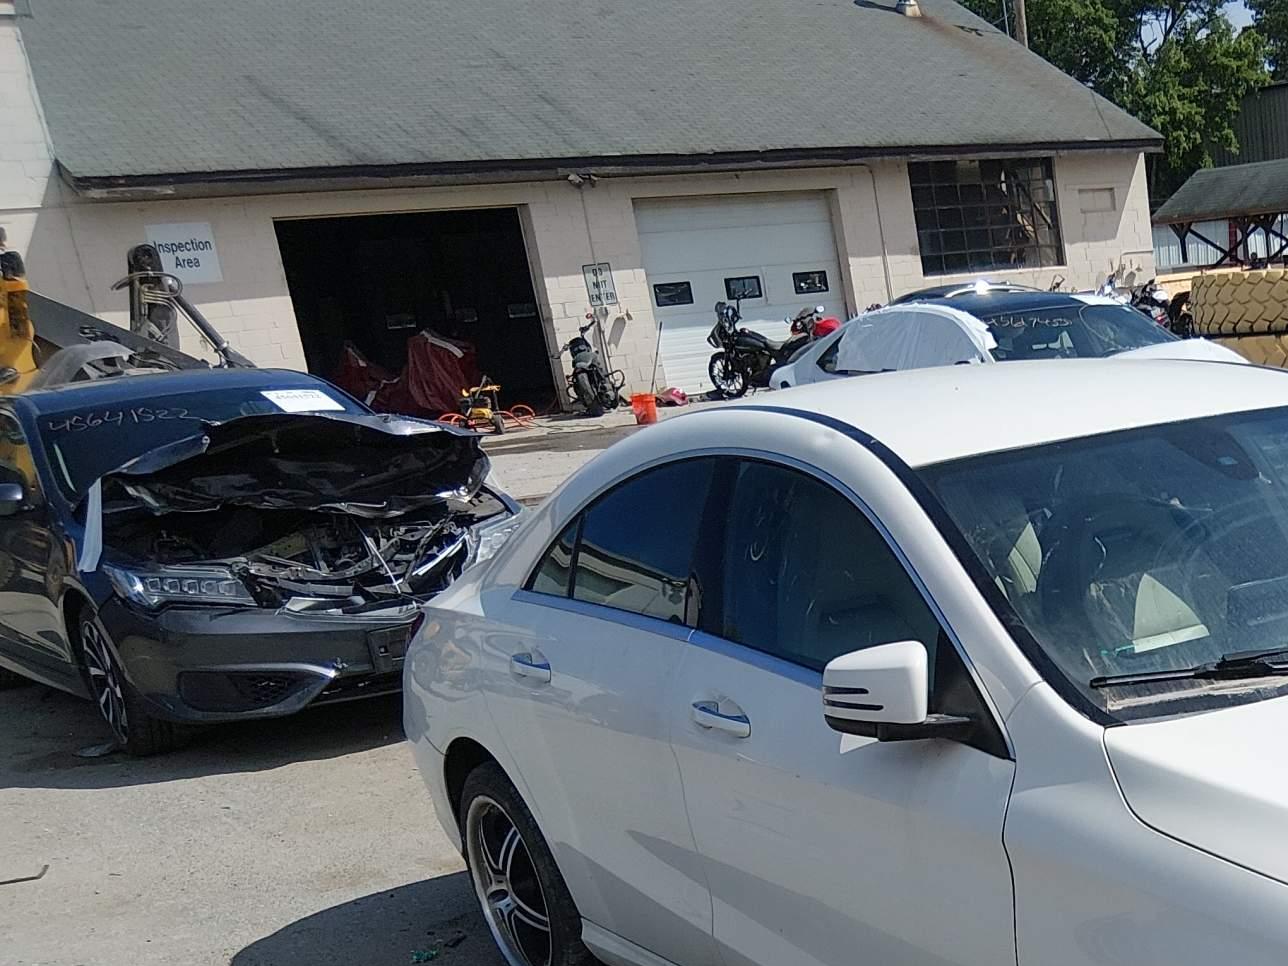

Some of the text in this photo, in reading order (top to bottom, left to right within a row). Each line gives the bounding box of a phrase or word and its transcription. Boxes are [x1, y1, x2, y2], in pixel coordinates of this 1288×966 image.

[153, 239, 212, 255] Inspection
[175, 256, 200, 268] Area
[591, 292, 615, 303] ENER
